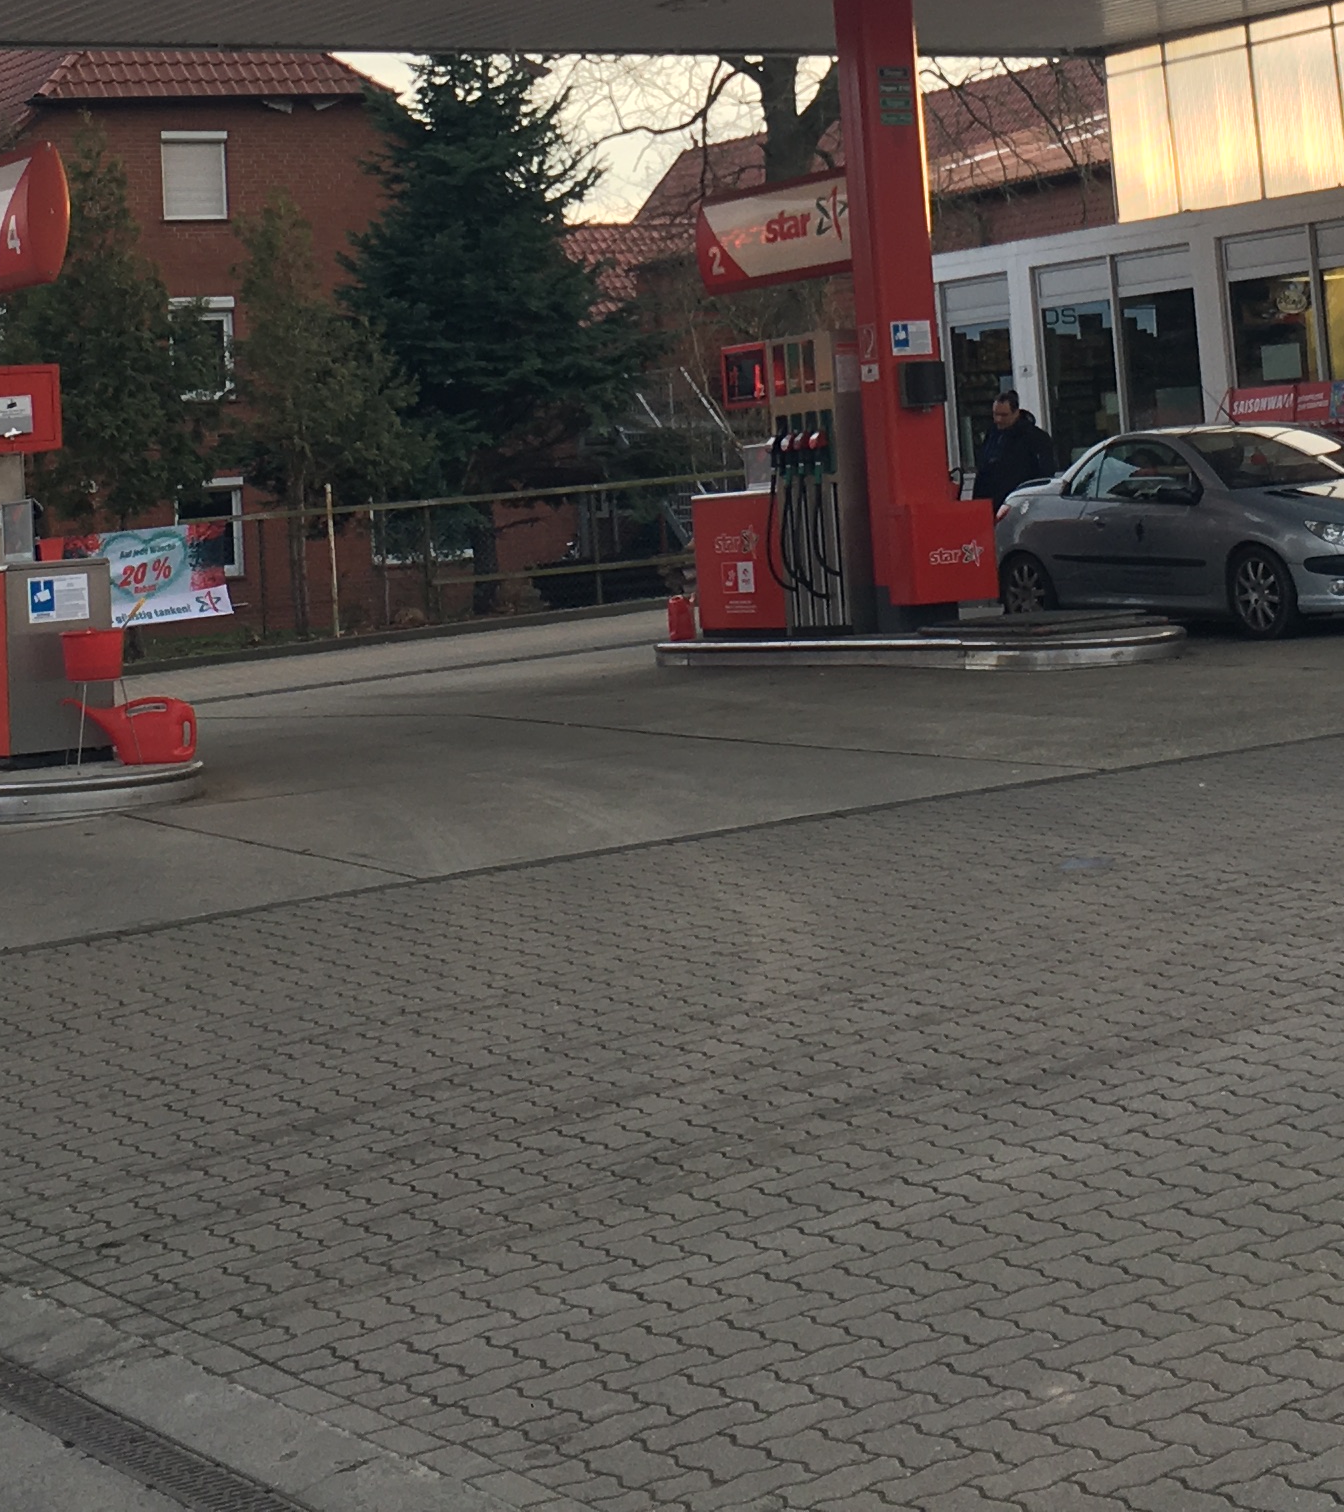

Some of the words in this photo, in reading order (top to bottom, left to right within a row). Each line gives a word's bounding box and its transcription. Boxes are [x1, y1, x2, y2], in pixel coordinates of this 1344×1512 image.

[8, 215, 20, 254] 4
[766, 210, 810, 244] star
[708, 246, 726, 276] 2
[119, 562, 147, 587] 20
[152, 556, 172, 581] %
[929, 548, 961, 565] star
